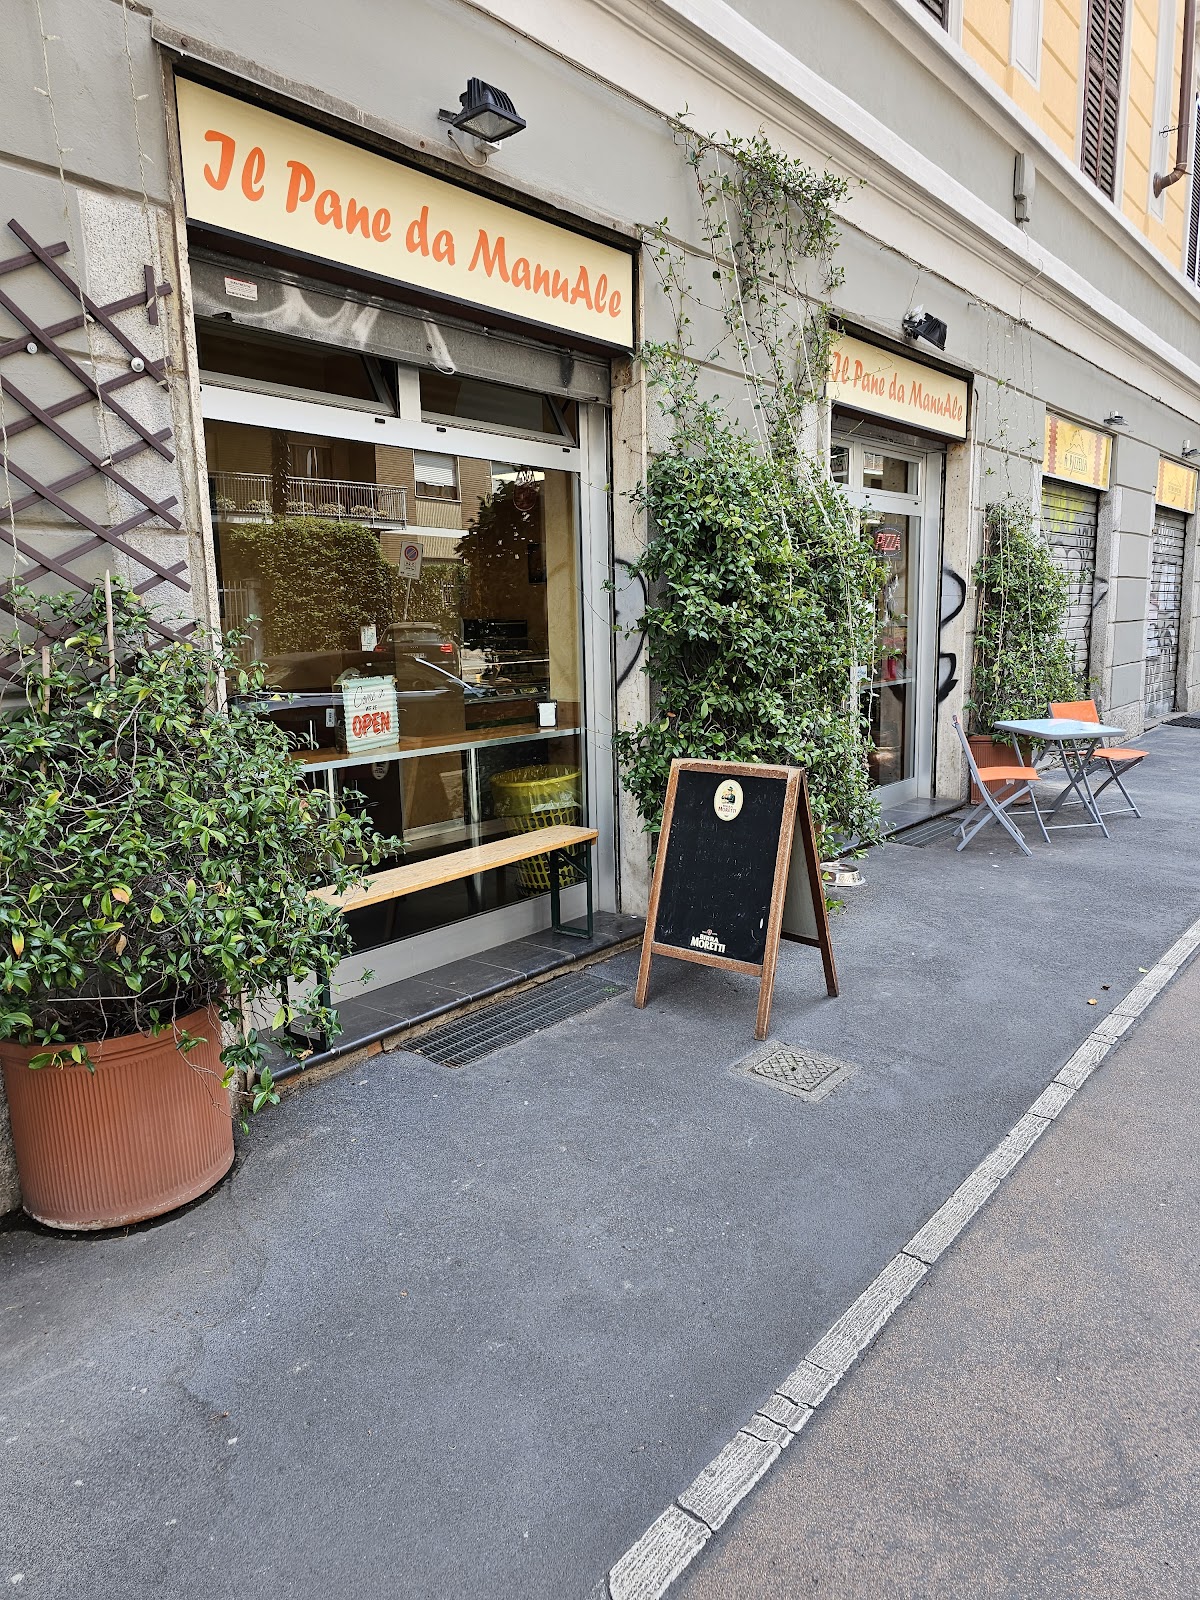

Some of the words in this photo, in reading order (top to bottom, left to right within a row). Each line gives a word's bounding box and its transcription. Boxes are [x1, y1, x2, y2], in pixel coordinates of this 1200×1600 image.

[203, 130, 266, 202] Il
[285, 160, 392, 243] Pane
[405, 205, 456, 266] da
[468, 229, 622, 319] ManuAle
[831, 351, 850, 385] Il
[853, 359, 886, 397] Pane
[888, 372, 905, 404] da
[908, 380, 963, 422] ManuAle
[875, 532, 901, 551] PIZZA
[352, 710, 391, 738] OPEN
[690, 935, 726, 953] MORETTI
[699, 933, 719, 944] BIRRA
